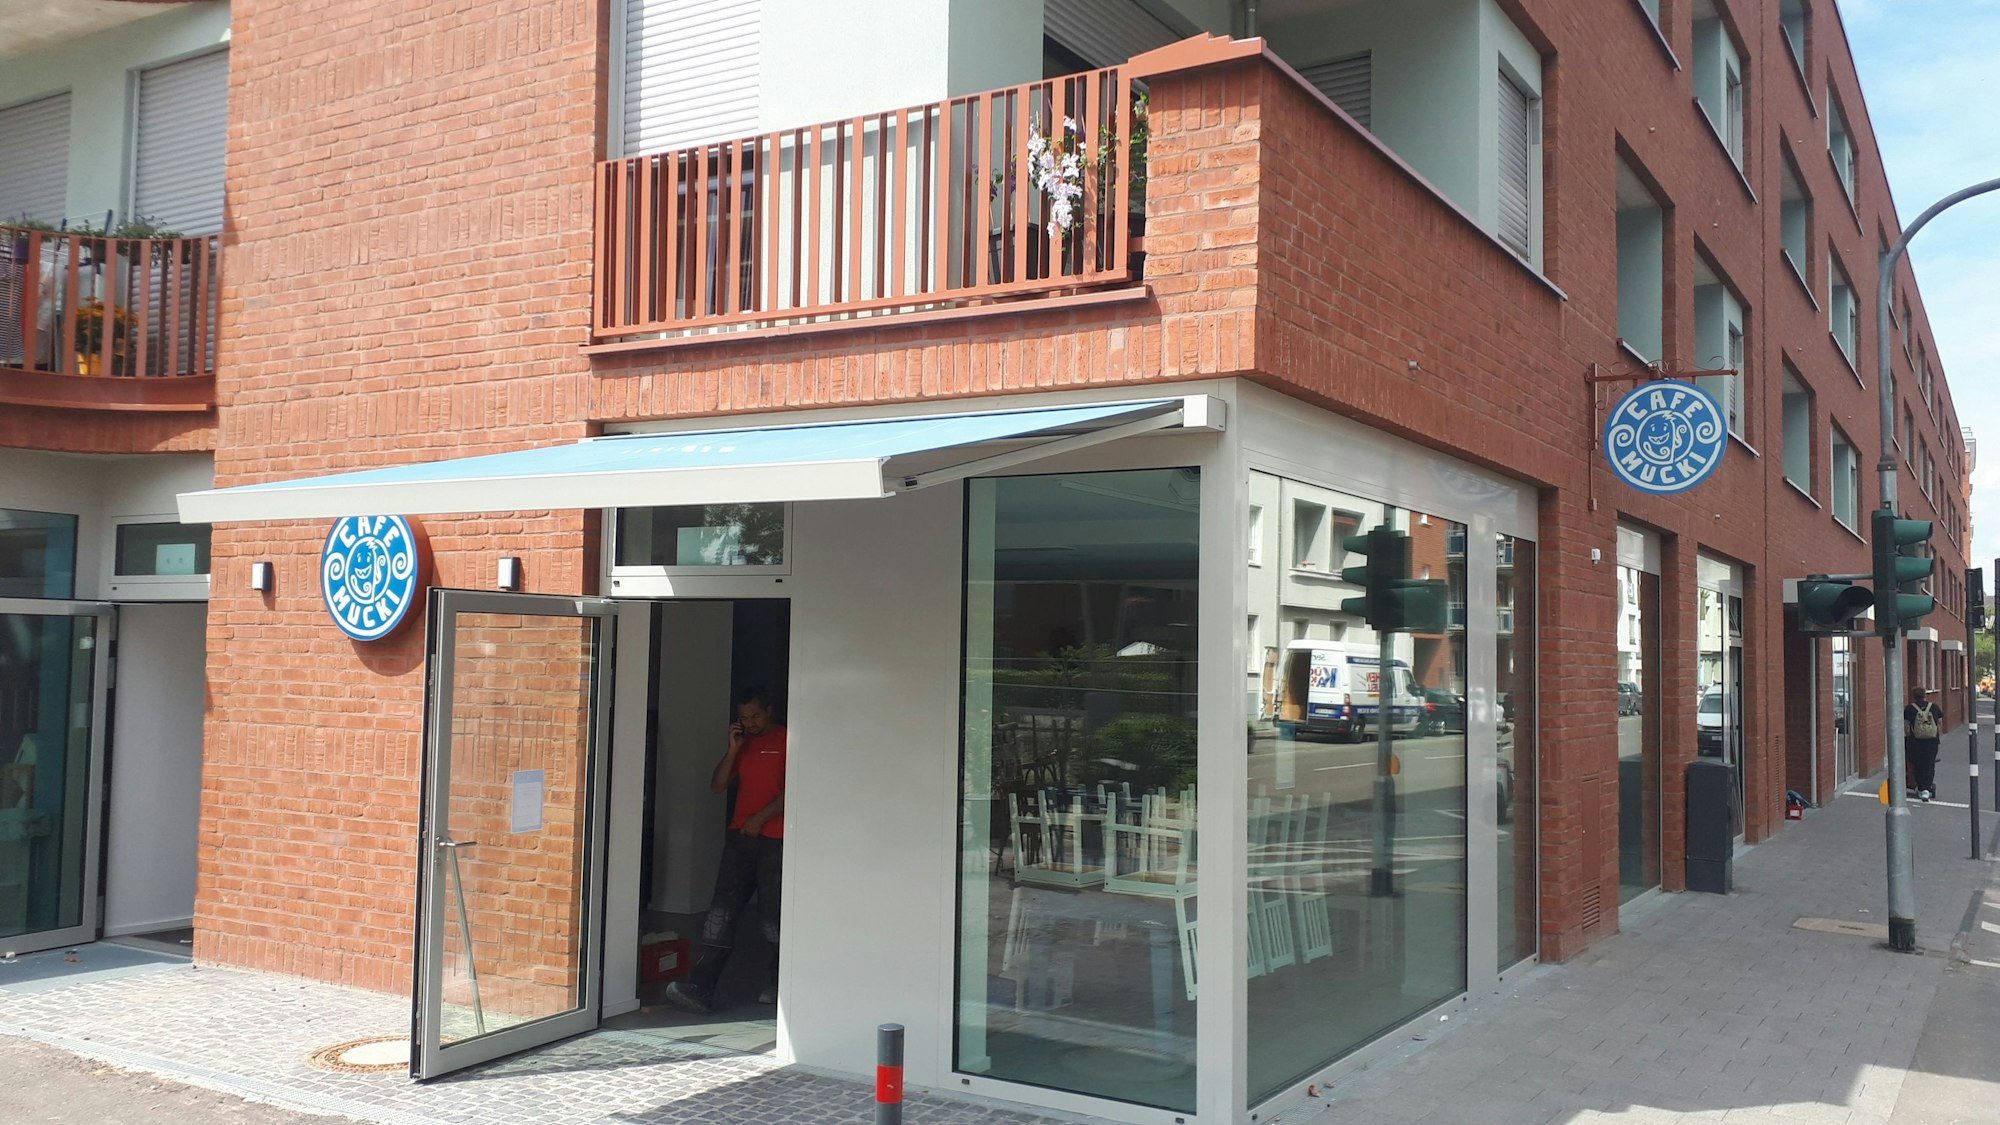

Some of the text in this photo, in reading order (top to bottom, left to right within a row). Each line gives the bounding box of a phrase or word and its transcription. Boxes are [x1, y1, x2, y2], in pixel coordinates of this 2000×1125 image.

[1626, 390, 1704, 420] CAFE
[1621, 450, 1707, 484] MUCKI
[339, 516, 400, 548] CAFE
[333, 586, 400, 628] MUCKI
